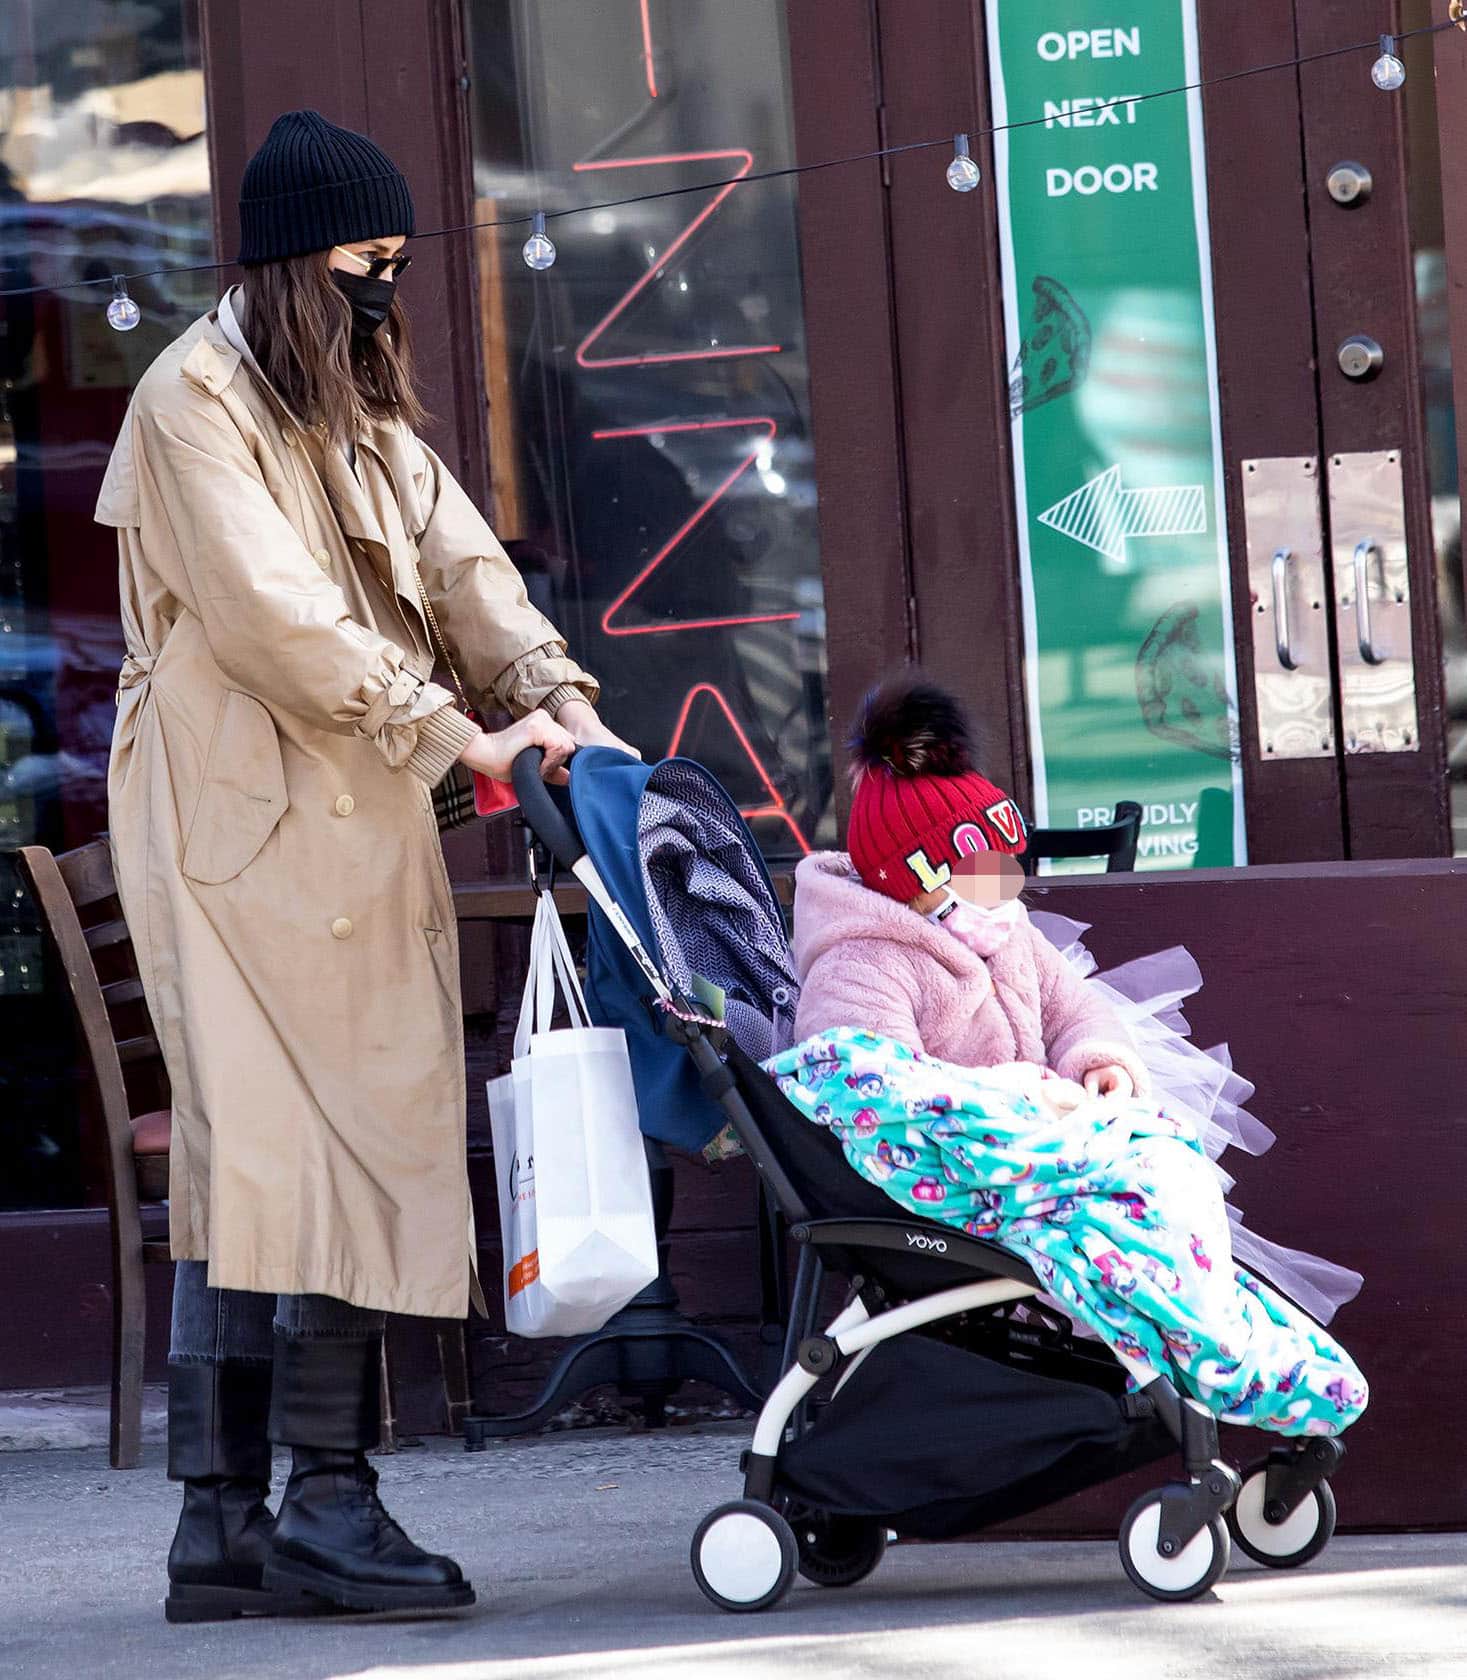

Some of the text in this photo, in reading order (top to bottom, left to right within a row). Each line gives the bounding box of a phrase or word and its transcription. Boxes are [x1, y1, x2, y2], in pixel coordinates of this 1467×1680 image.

[1037, 27, 1141, 61] OPEN
[1043, 95, 1143, 129] NEXT
[1046, 163, 1158, 197] DOOR
[1077, 802, 1198, 828] PRUDLY
[905, 797, 1028, 894] LOV
[905, 1232, 947, 1253] YOYO
